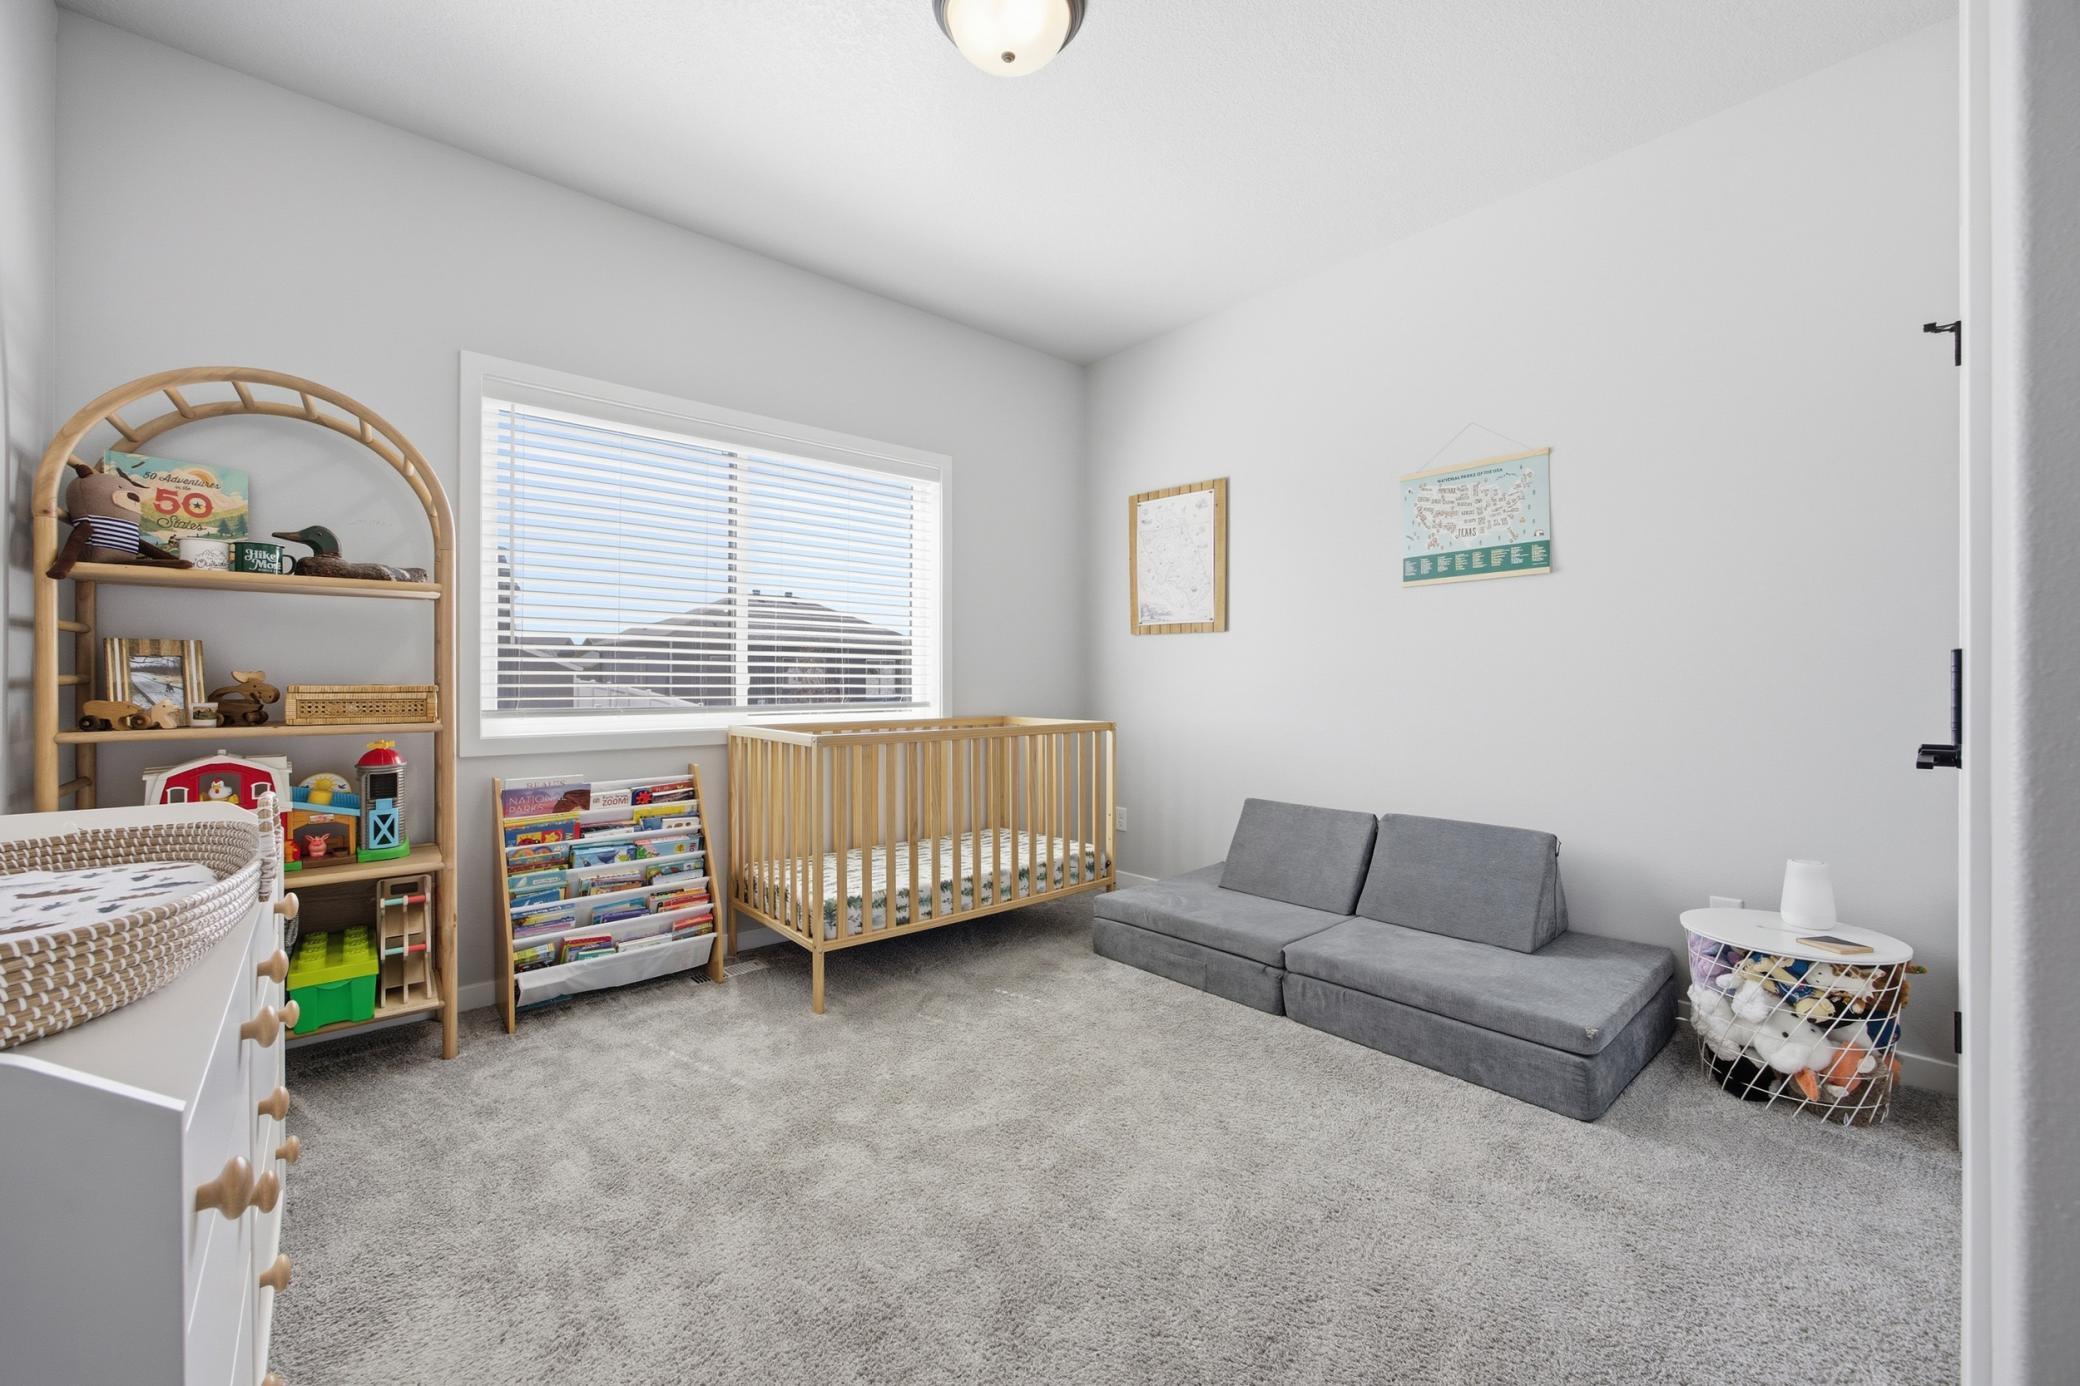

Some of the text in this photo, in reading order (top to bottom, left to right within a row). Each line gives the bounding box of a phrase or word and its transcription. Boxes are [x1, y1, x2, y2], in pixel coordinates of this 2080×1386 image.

[142, 471, 222, 490] 50 Adventures
[153, 487, 214, 519] 50
[157, 515, 207, 531] States
[244, 548, 278, 562] Hike
[509, 794, 567, 806] NATIONAL
[509, 804, 545, 814] PARKS
